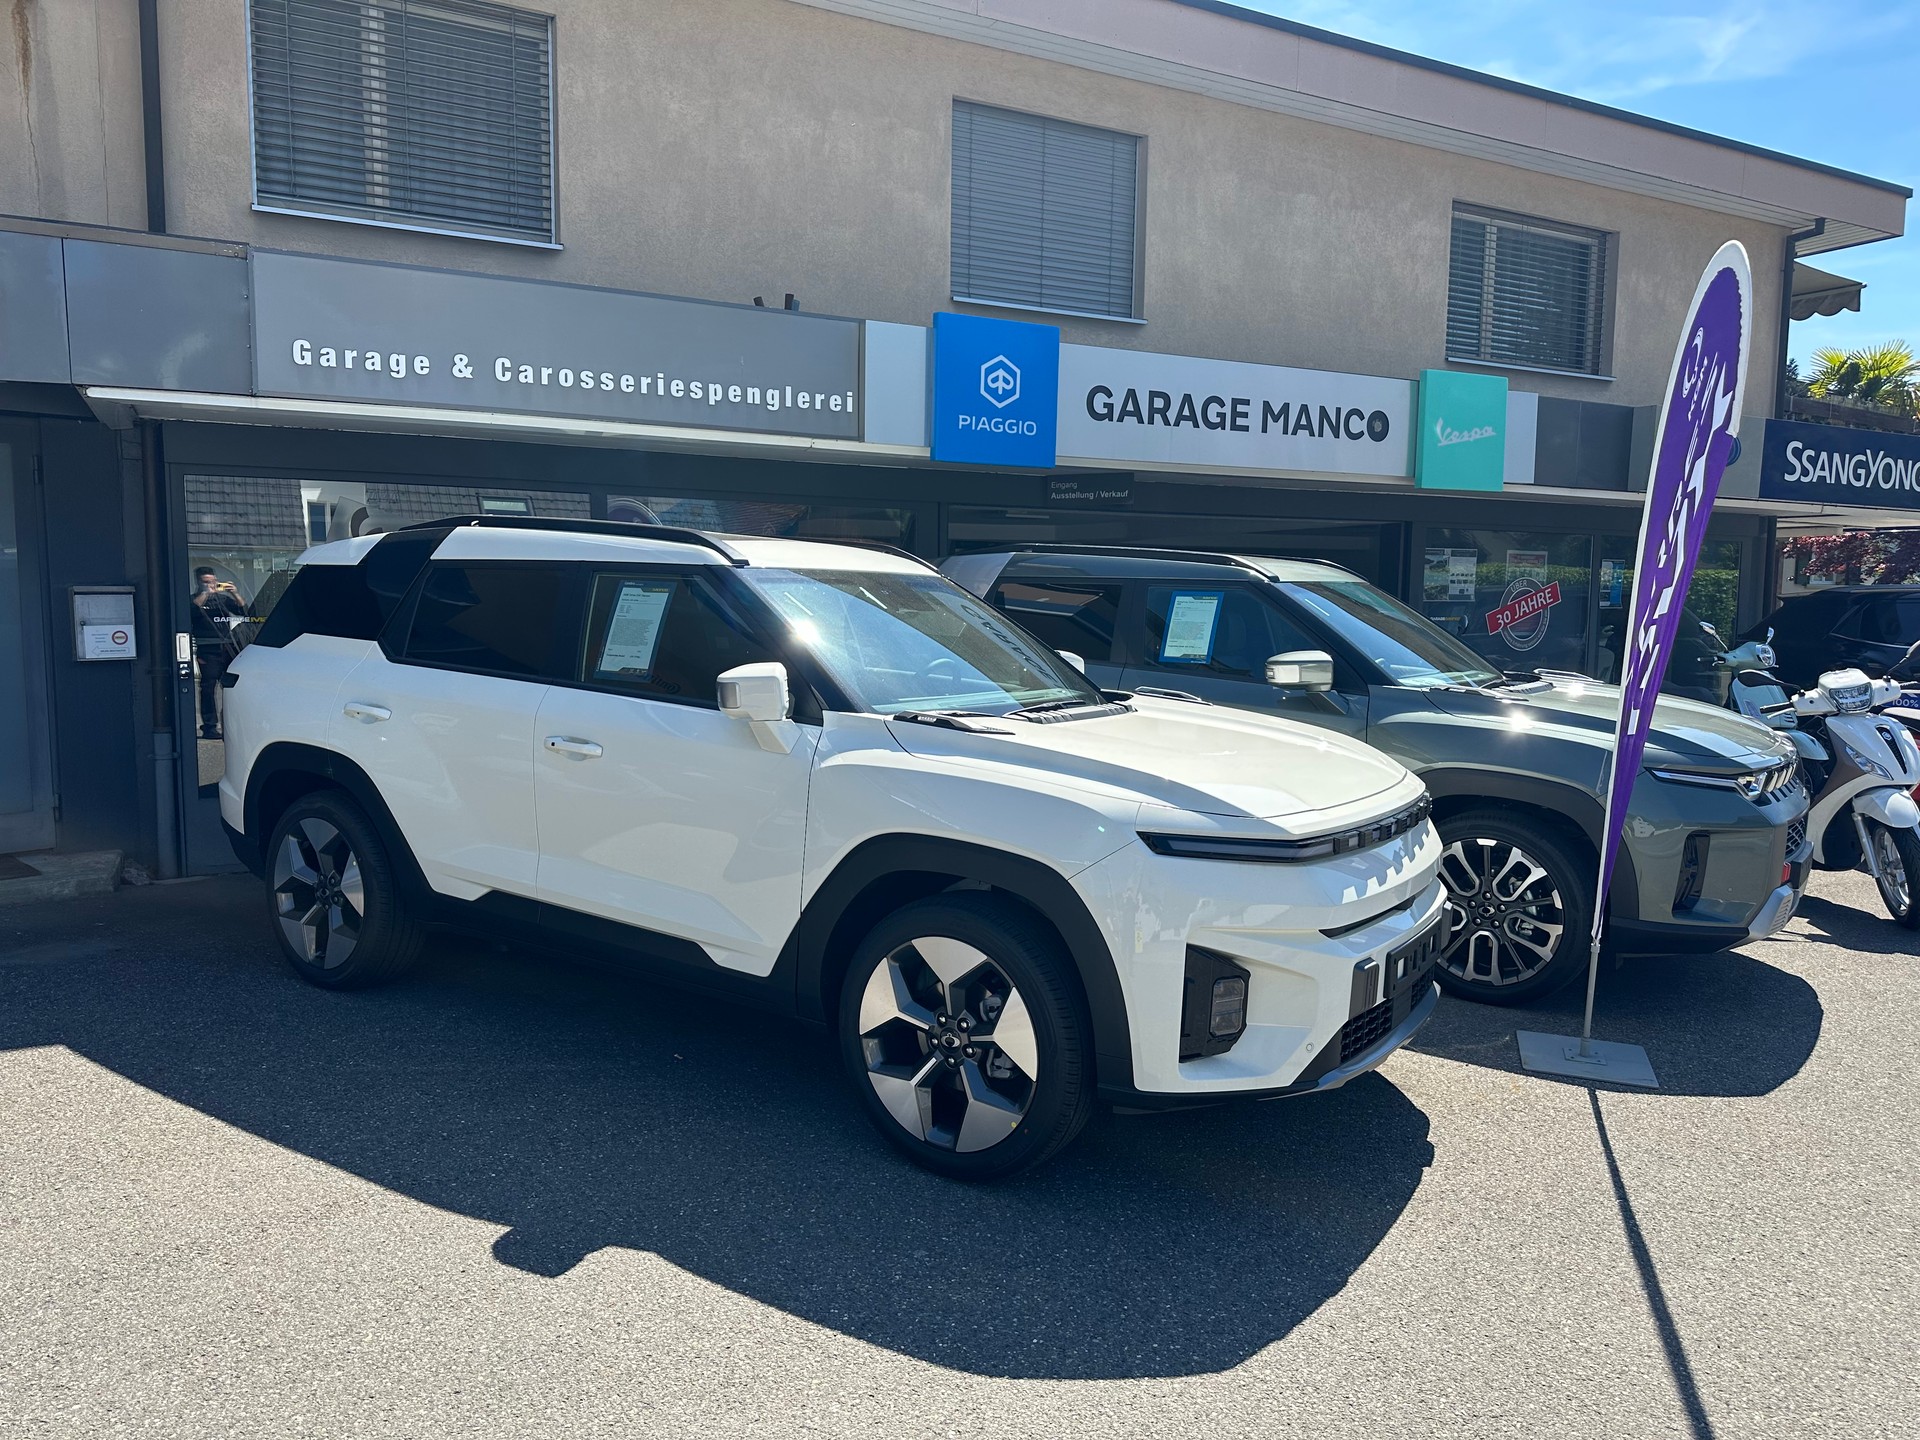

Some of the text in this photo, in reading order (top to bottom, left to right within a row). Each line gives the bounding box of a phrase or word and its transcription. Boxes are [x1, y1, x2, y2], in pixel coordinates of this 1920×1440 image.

[292, 339, 854, 413] Garage & Carosseriespenglerei
[958, 414, 1037, 437] PIAGGIO
[1086, 384, 1390, 443] GARAGE MANCO
[1436, 417, 1496, 447] Vespa
[1050, 491, 1094, 500] Ausstellung
[1100, 490, 1129, 498] Verkauf
[1051, 481, 1078, 489] Eingang
[1496, 610, 1511, 630] 30
[1514, 588, 1554, 619] JAHRE
